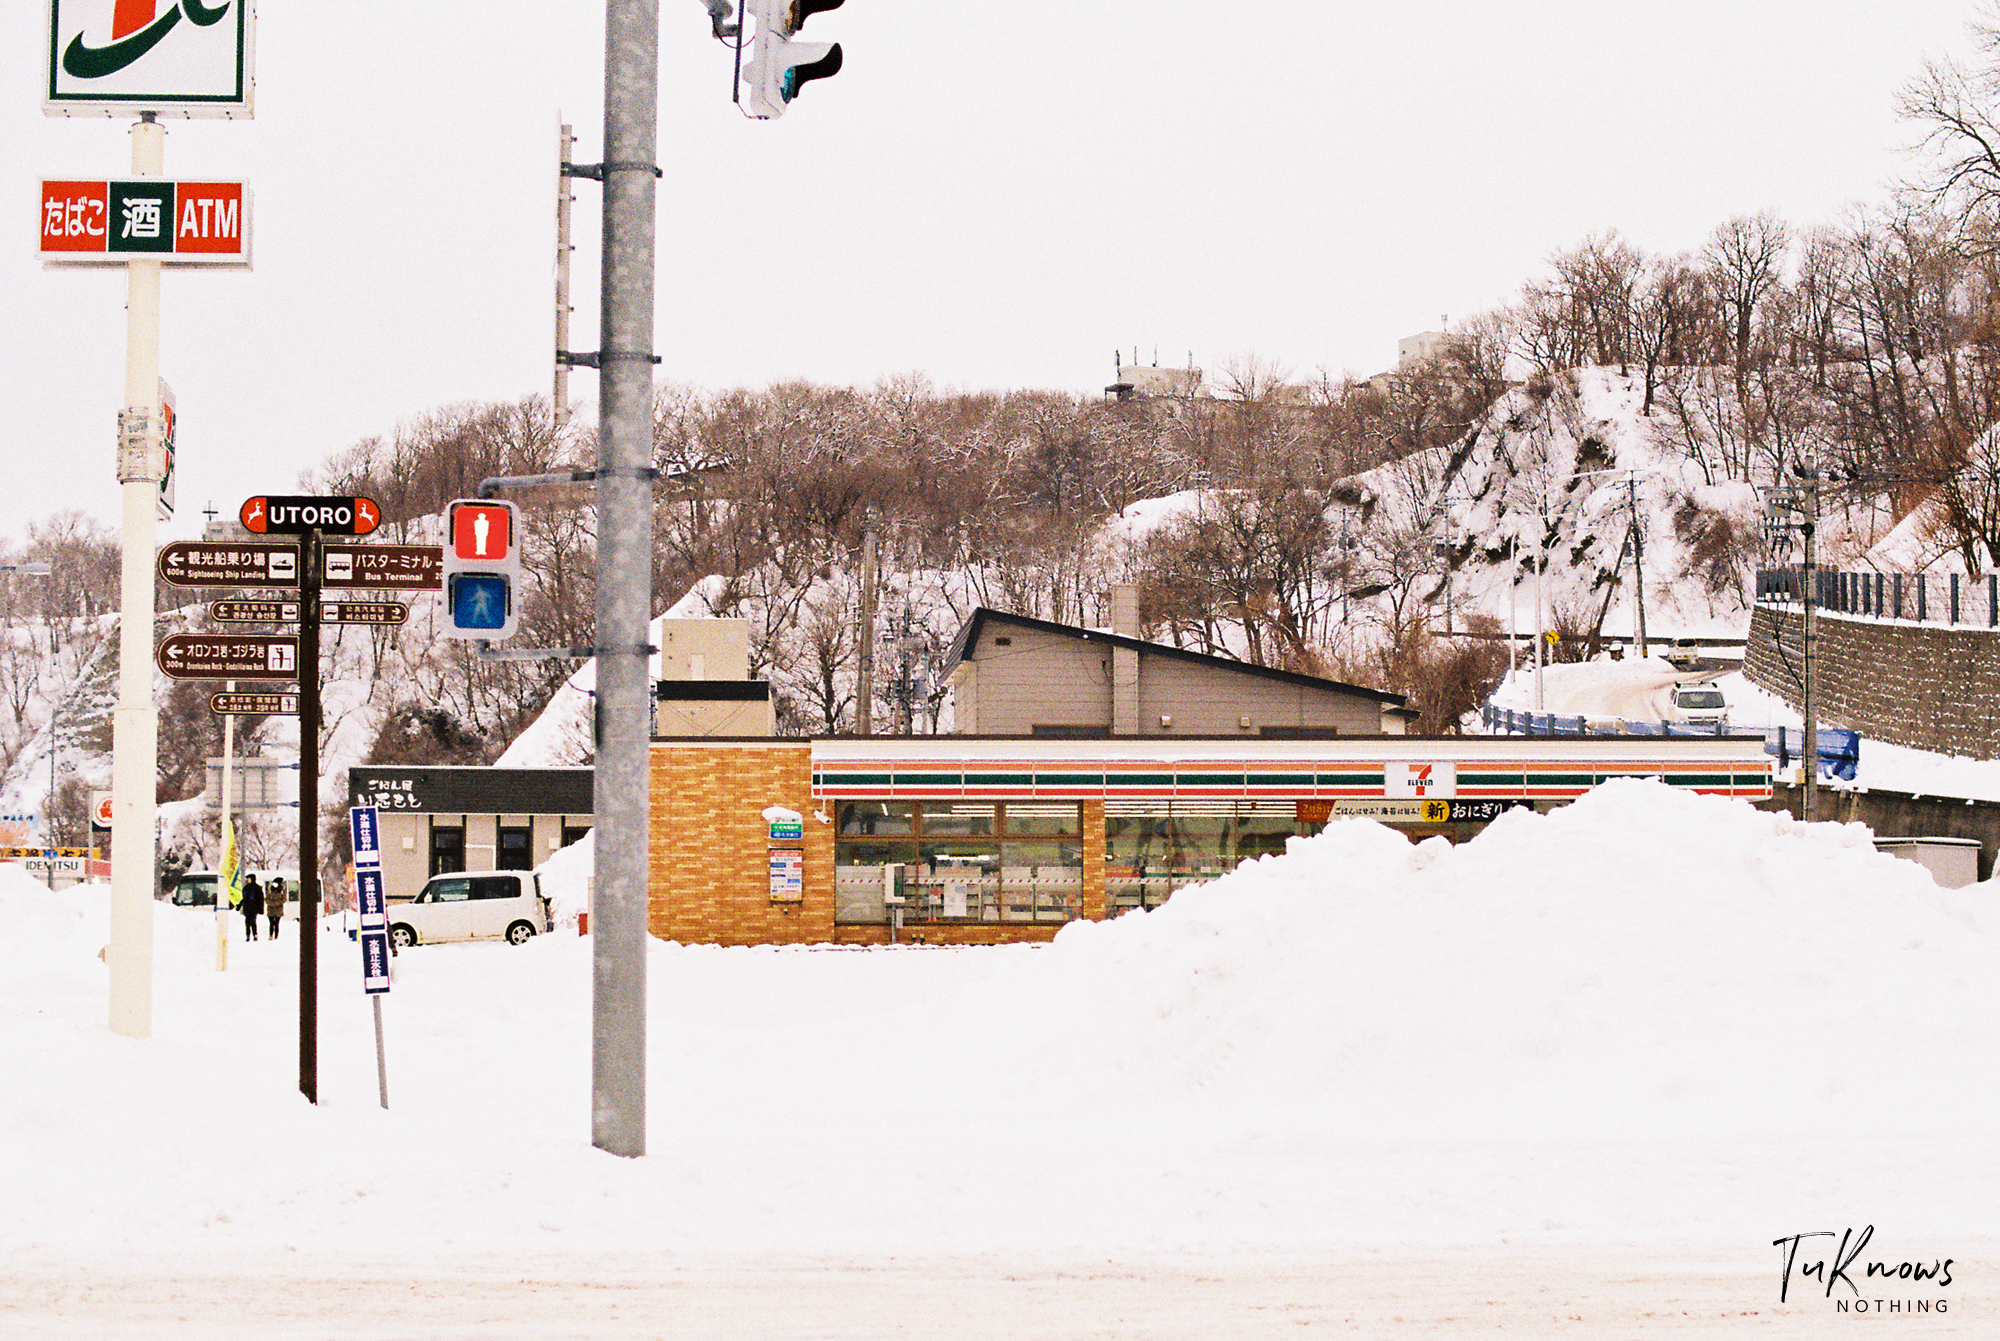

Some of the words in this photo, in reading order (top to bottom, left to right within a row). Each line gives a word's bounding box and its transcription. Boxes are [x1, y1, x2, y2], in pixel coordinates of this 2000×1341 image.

[44, 196, 104, 237] たばこ
[121, 197, 162, 238] 酒
[179, 198, 238, 238] ATM
[270, 506, 351, 526] UTORO
[188, 551, 266, 567] 観光船乗り場
[355, 554, 433, 569] バスターミナル
[225, 570, 240, 580] Ship
[241, 570, 266, 581] Landing
[364, 572, 382, 581] Bus
[384, 572, 423, 581] Terminal
[1408, 764, 1432, 796] 7
[1426, 802, 1445, 820] 新
[1452, 802, 1503, 819] おにぎり
